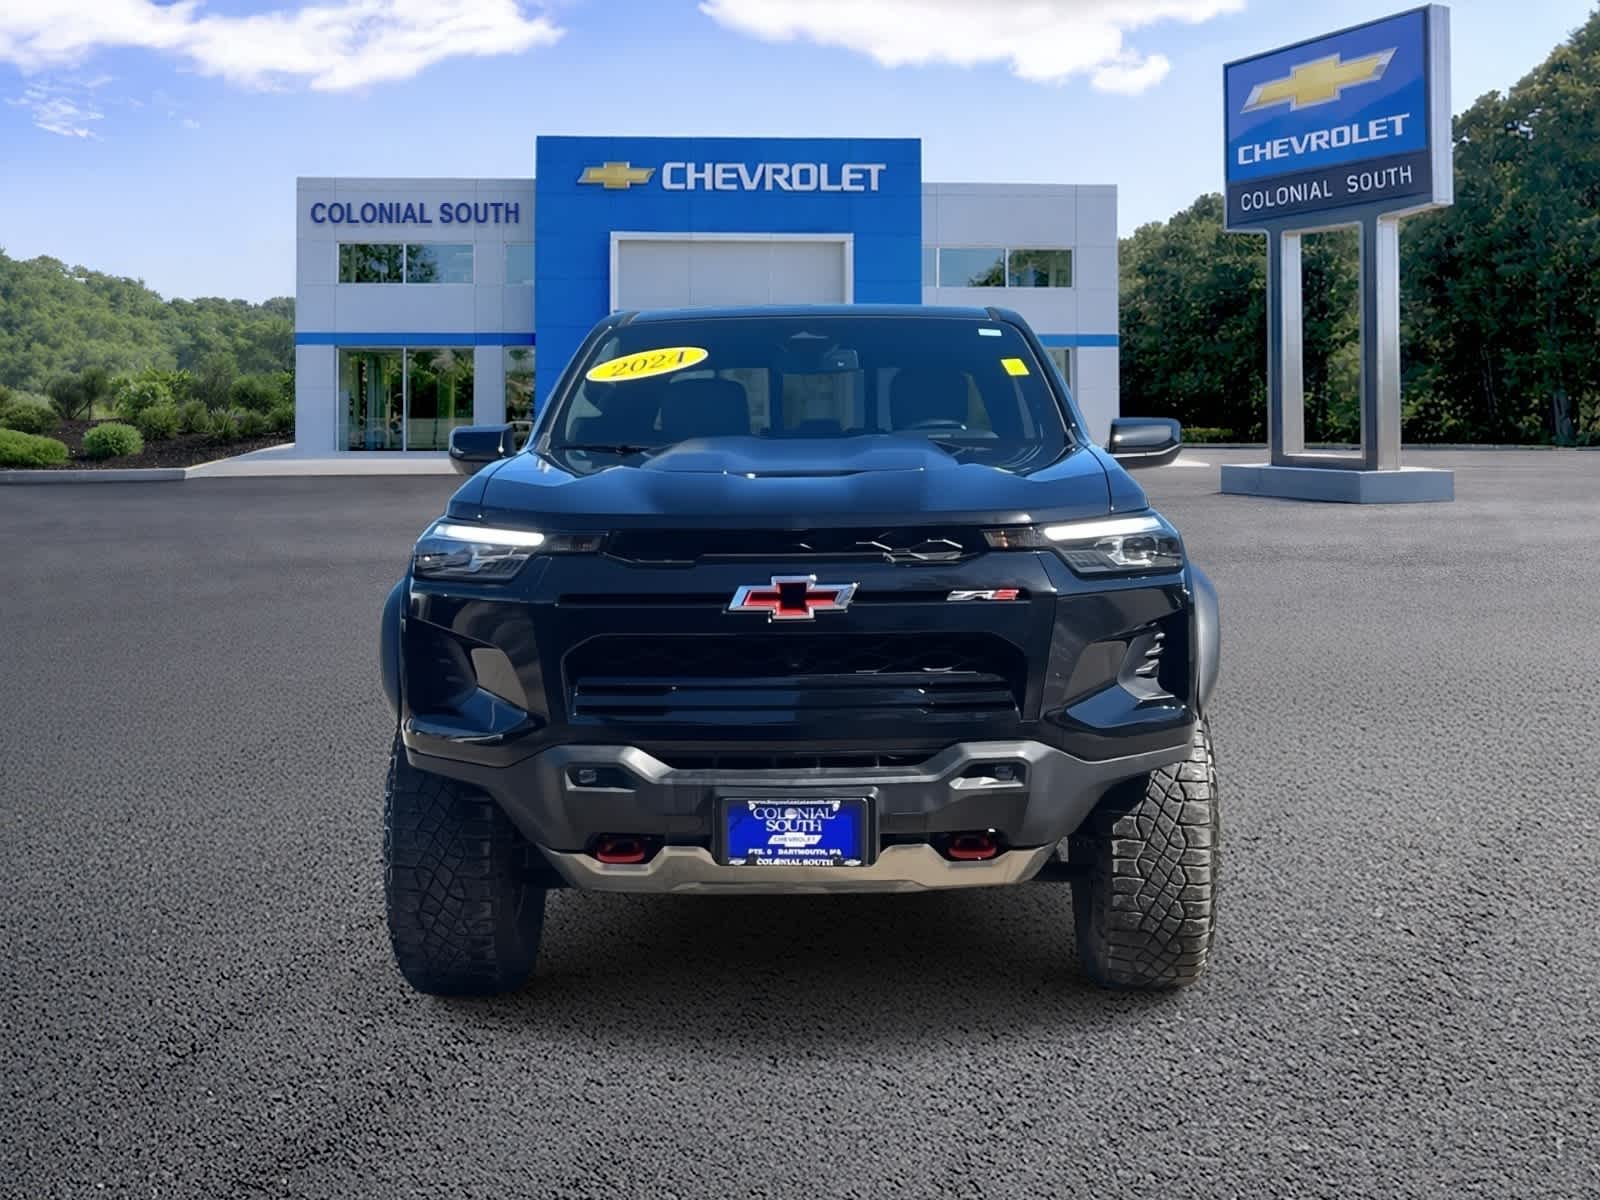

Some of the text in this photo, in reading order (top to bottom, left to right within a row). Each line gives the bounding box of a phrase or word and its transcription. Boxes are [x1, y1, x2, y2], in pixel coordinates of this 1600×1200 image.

[1238, 113, 1410, 165] CHEVROLET
[662, 162, 887, 191] CHEVROLET
[1241, 165, 1412, 211] COLONIAL SOUTH
[311, 202, 520, 224] COLONIAL SOUTH
[611, 351, 687, 377] 2024
[753, 807, 836, 820] COLONIAL
[766, 819, 823, 832] SOUTH
[803, 858, 834, 866] SOUTH
